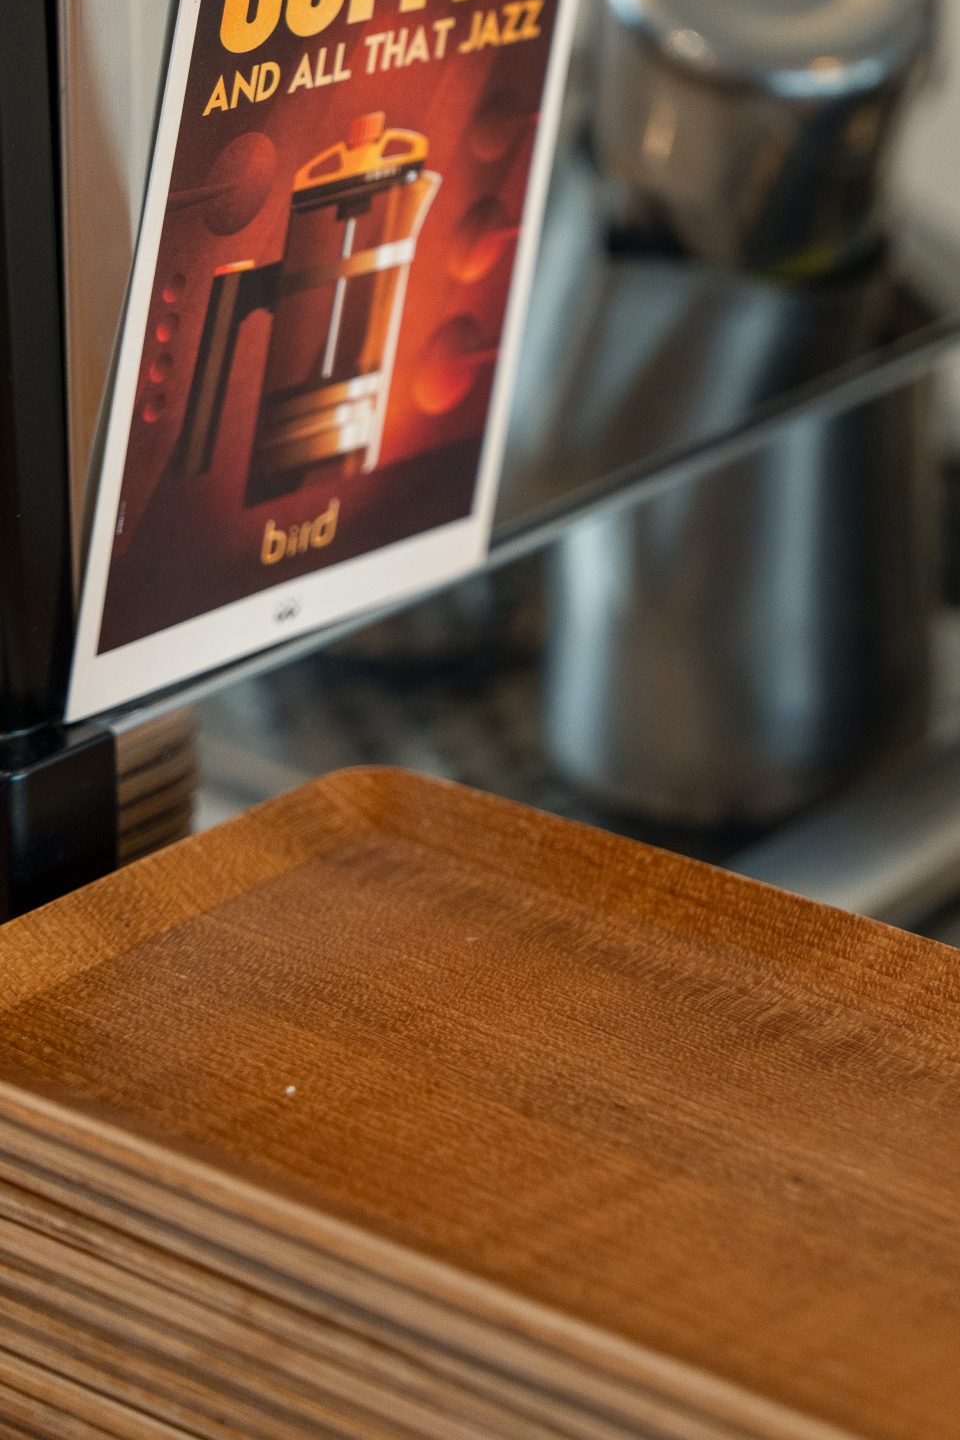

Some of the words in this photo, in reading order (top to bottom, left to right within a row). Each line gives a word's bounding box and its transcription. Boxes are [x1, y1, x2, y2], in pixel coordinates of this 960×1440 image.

[202, 61, 281, 116] AND
[288, 42, 352, 94] ALL
[365, 17, 456, 74] THAT
[261, 497, 341, 566] bird
